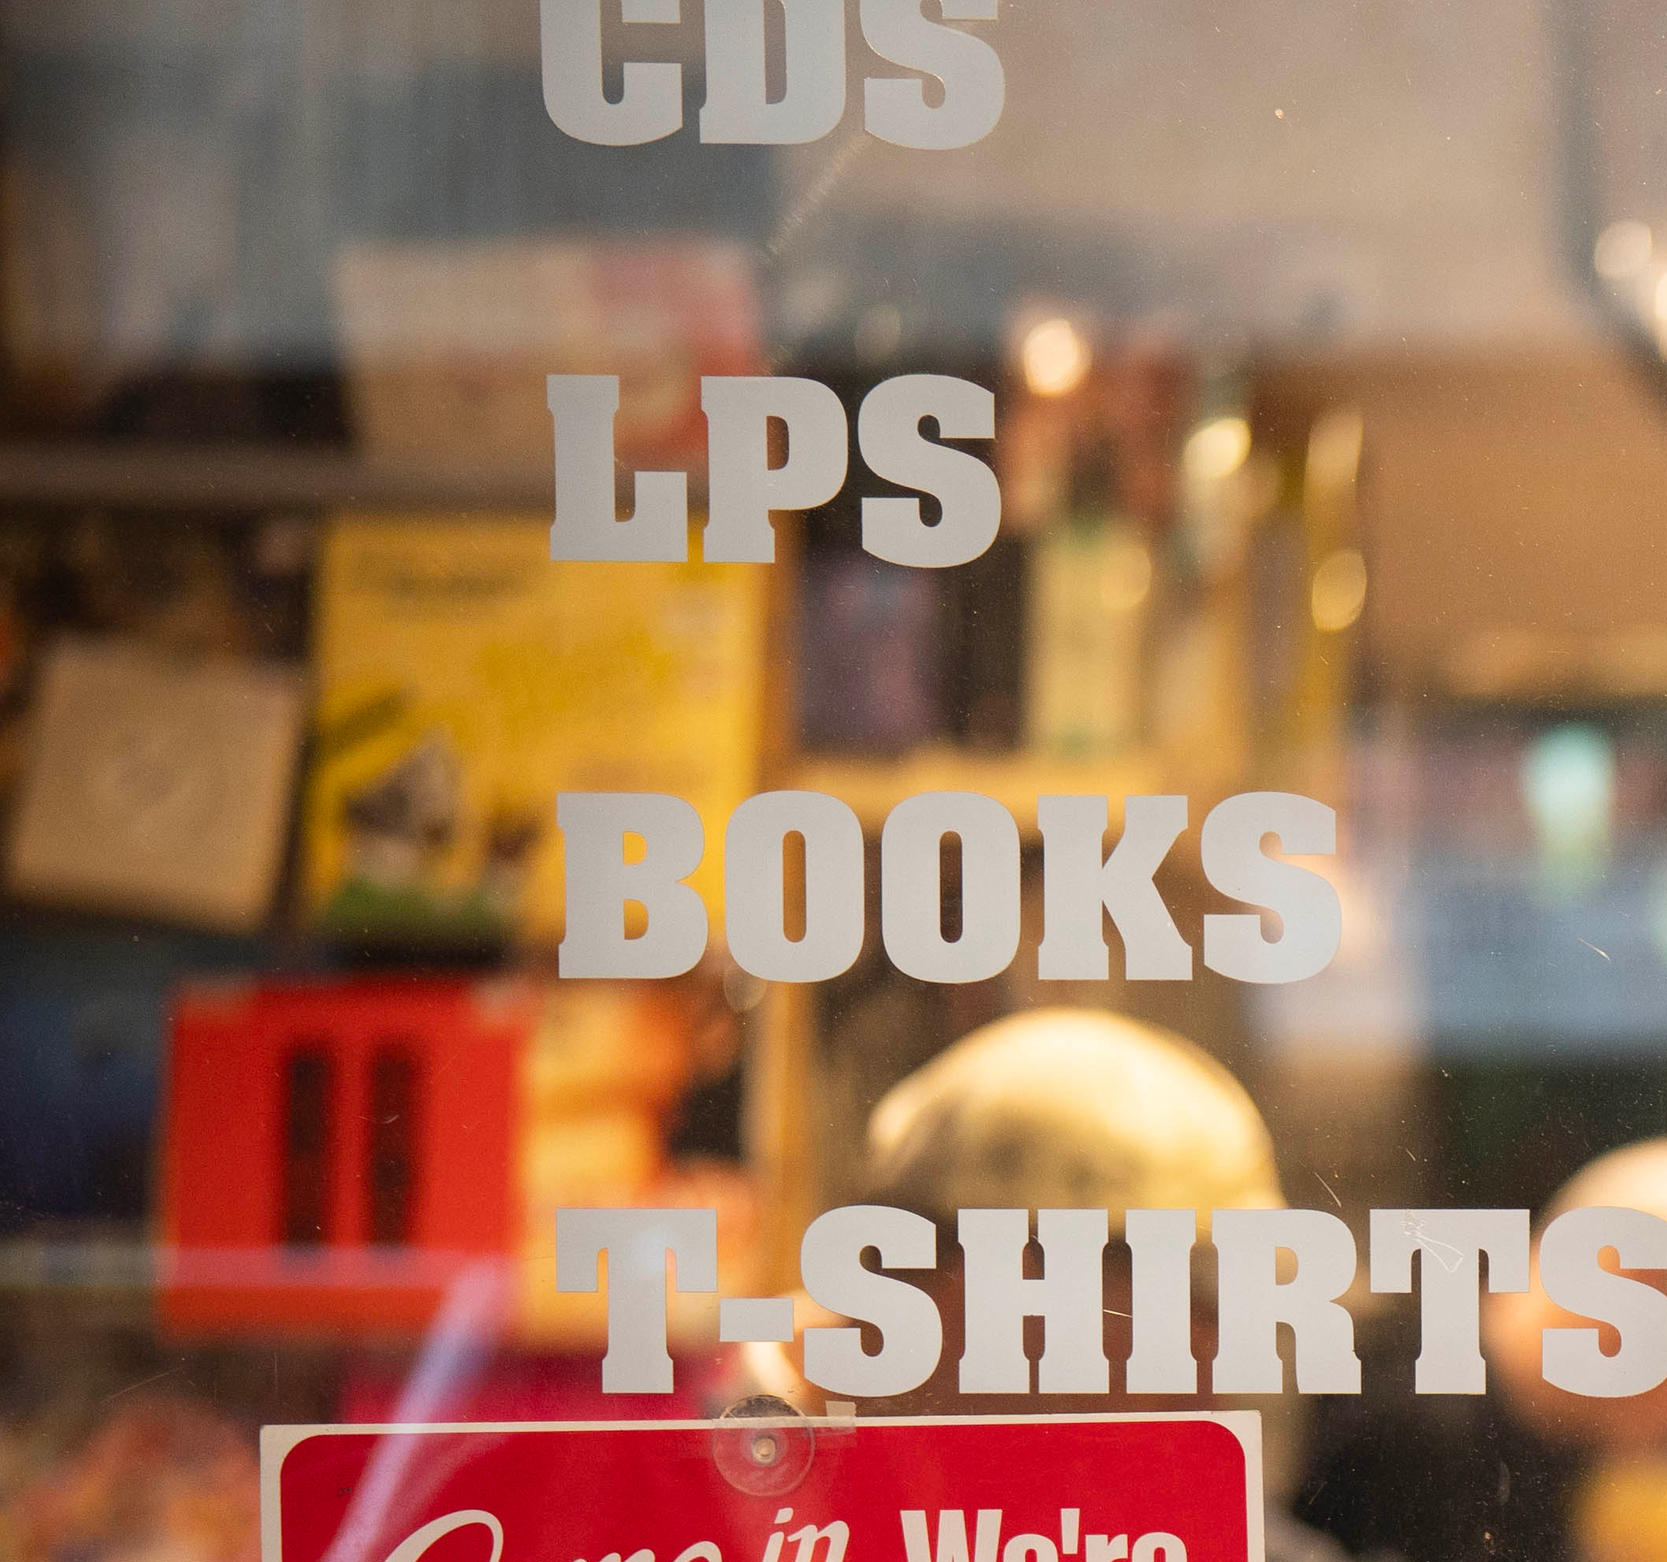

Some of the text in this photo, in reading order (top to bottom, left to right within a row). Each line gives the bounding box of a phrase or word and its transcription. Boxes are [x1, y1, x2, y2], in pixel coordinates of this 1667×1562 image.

[540, 0, 1006, 150] CDS
[546, 374, 1002, 568] LPS
[556, 791, 1341, 984] BOOKS
